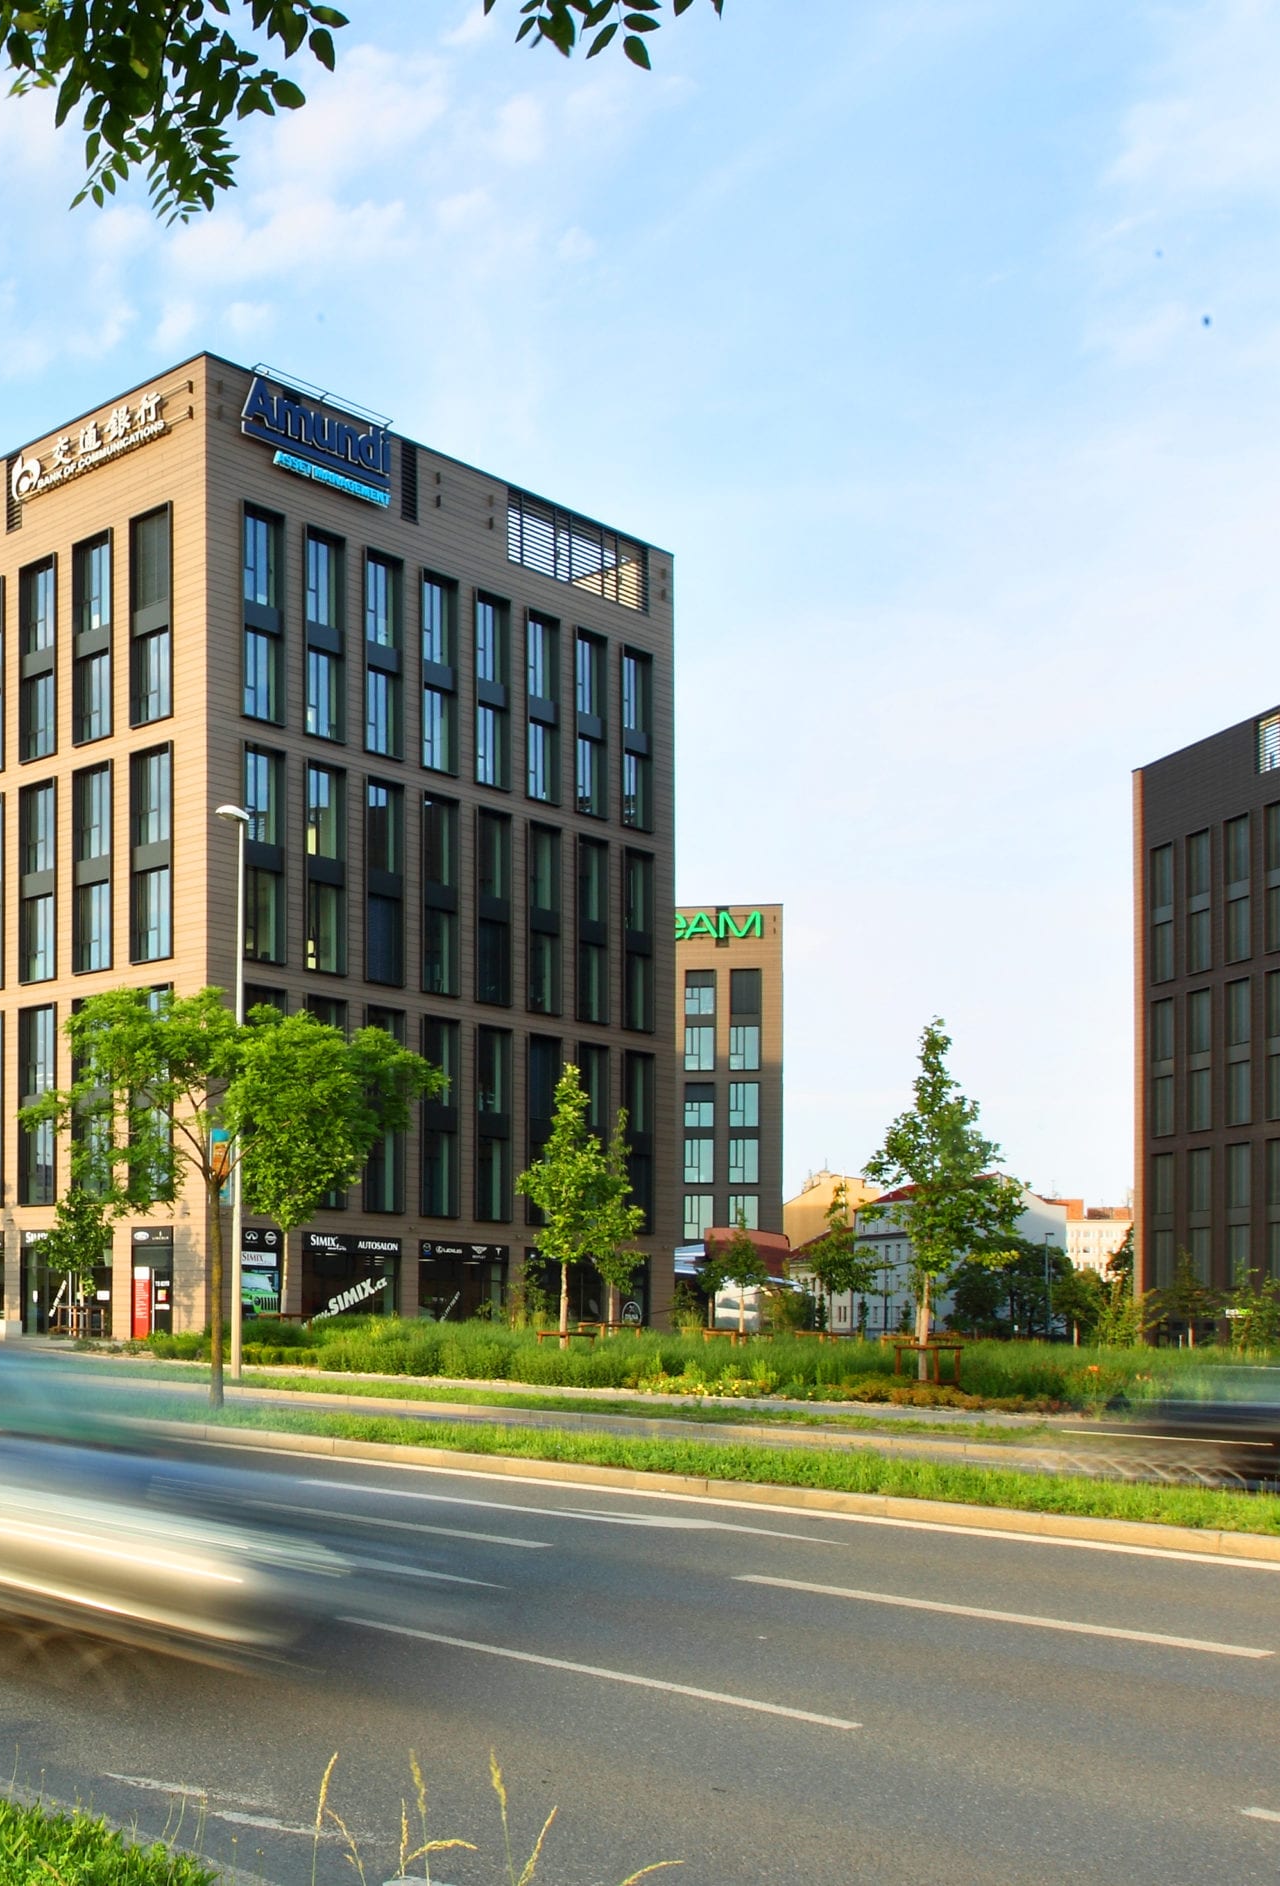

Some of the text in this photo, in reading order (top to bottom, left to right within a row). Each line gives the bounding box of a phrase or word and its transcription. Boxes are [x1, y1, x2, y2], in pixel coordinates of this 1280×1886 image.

[37, 418, 166, 490] BANK OF COMMUNICATIONS
[240, 376, 391, 477] Amundi
[273, 450, 391, 509] ASSET MANAGEMENT
[310, 1234, 337, 1247] SIMIX
[357, 1240, 399, 1251] AUTOSALON
